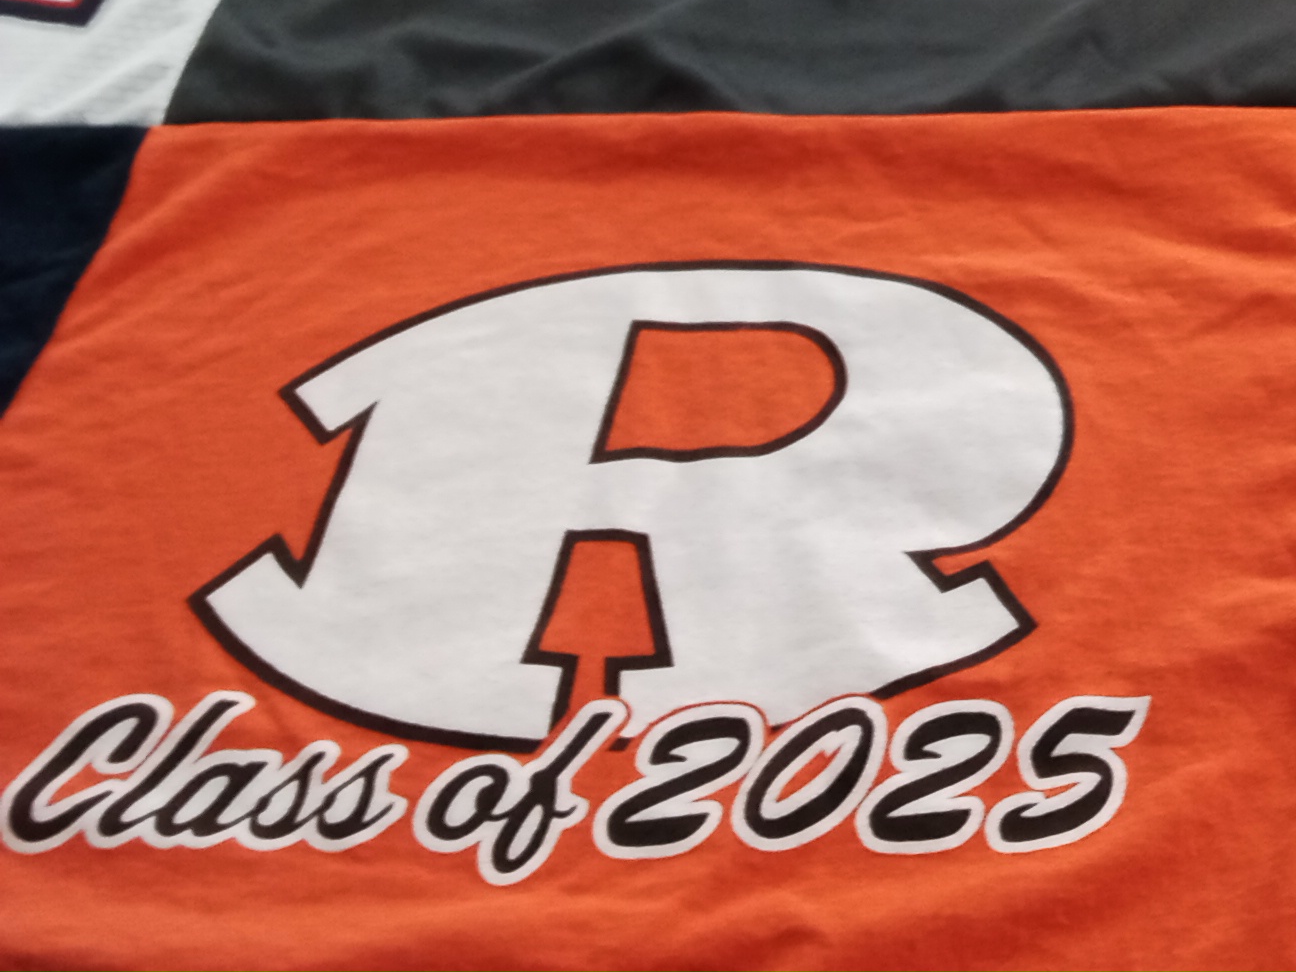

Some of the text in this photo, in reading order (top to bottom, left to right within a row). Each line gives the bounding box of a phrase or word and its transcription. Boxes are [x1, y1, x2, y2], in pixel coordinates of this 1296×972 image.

[186, 260, 1074, 752] R
[2, 691, 1152, 885] Class of 2025
